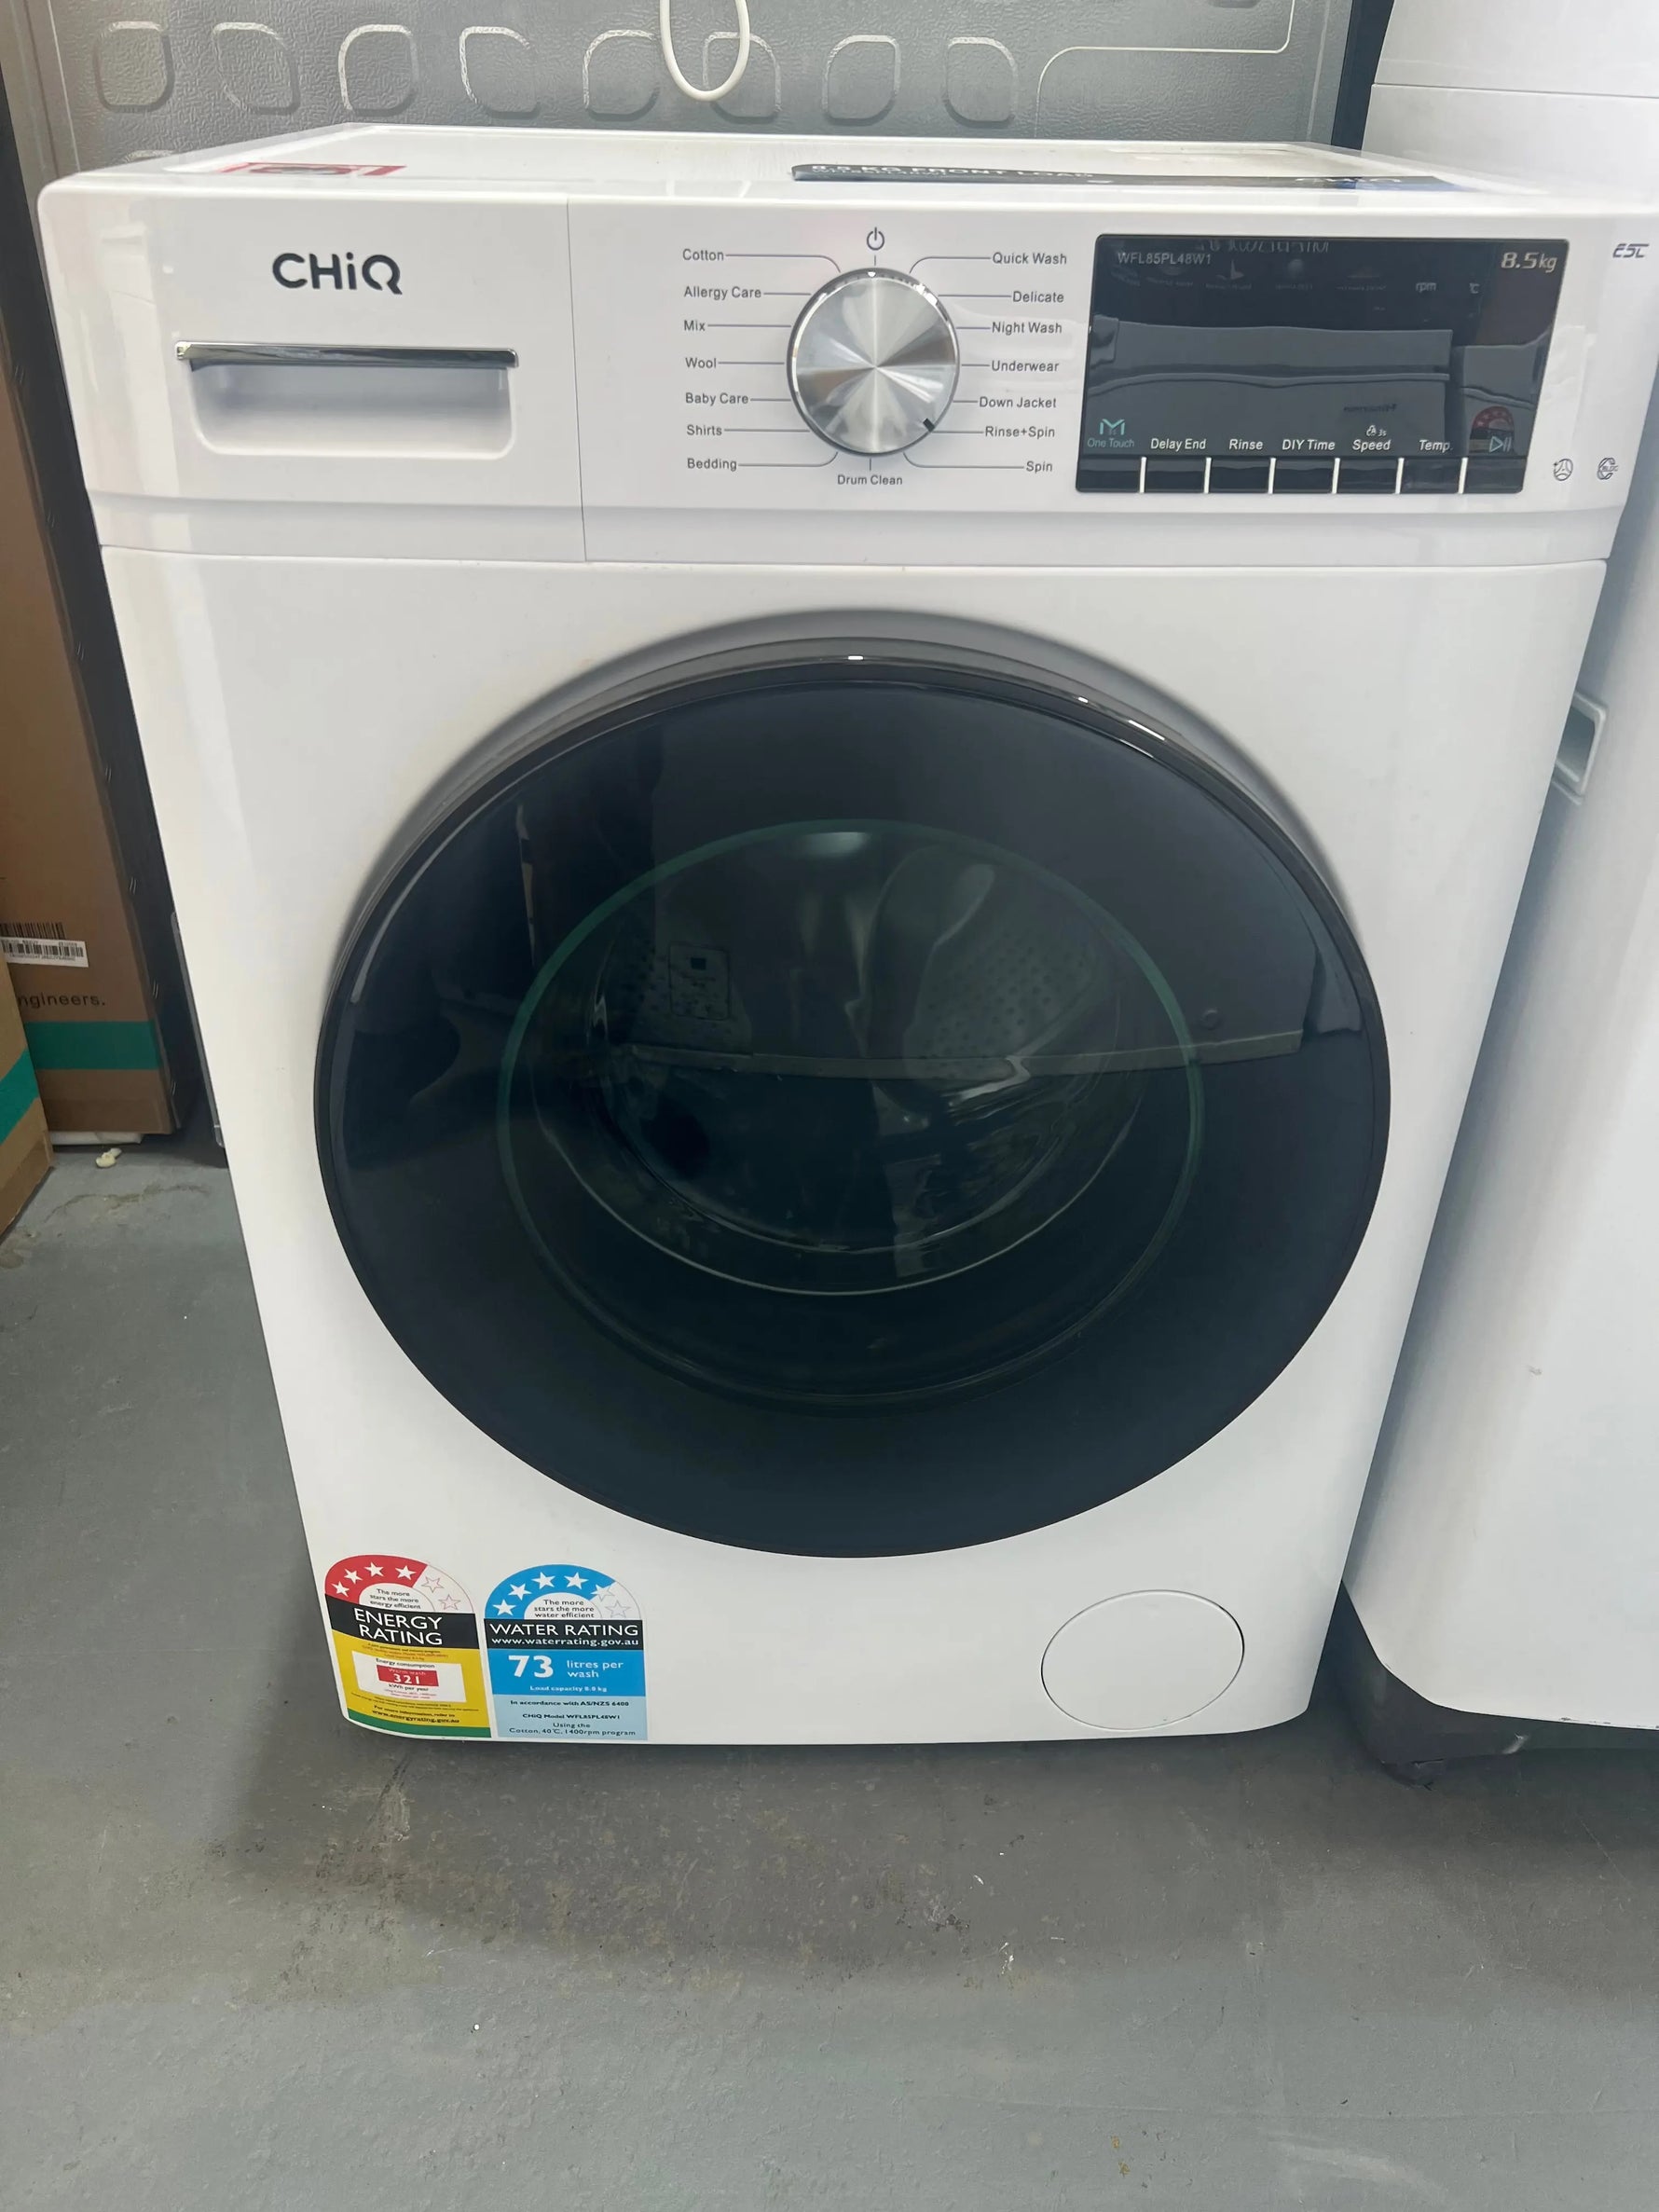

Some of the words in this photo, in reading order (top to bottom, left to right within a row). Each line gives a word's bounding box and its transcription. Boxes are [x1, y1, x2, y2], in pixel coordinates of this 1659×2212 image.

[912, 167, 1007, 175] FRONT
[682, 248, 724, 261] Cotton
[1611, 243, 1650, 258] ESC
[993, 252, 1029, 265] Quick
[1033, 253, 1067, 265] Wash
[1117, 252, 1212, 266] WFL85PL48W1
[272, 252, 403, 295] CHiQ
[683, 286, 728, 300] Allergy
[732, 286, 761, 298] Care
[1416, 282, 1437, 293] rpm
[1012, 290, 1064, 303] Delicate
[683, 320, 706, 332] Mix
[992, 322, 1024, 336] Night
[1028, 322, 1063, 334] Wash
[685, 358, 717, 369] Wool
[992, 360, 1059, 372] Underwear
[685, 392, 716, 406] Baby
[720, 392, 749, 405] Care
[980, 396, 1013, 408] Down
[1016, 397, 1057, 408] Jacket
[686, 424, 722, 436] Shirts
[985, 426, 1055, 439] Rinse+Spin
[1087, 437, 1107, 448] One
[1108, 437, 1135, 448] Touch
[1150, 437, 1184, 452] Delay
[1185, 438, 1207, 450] End
[1228, 438, 1264, 450] Rinse
[1282, 439, 1305, 451] DIY
[1307, 439, 1336, 451] Time
[1351, 439, 1392, 453] Speed
[687, 458, 737, 472] Bedding
[1026, 460, 1053, 474] Spin
[837, 474, 868, 486] Drum
[870, 474, 903, 486] Clean
[19, 991, 106, 1009] ngineers.
[370, 1601, 392, 1609] energy
[353, 1607, 443, 1630] ENERGY
[359, 1624, 443, 1645] RATING
[489, 1624, 559, 1636] WATER
[565, 1624, 638, 1636] RATING
[491, 1638, 639, 1647] www.waterrating.gov.au
[508, 1655, 554, 1678] 73
[567, 1660, 598, 1669] litres
[602, 1662, 624, 1670] per
[393, 1673, 420, 1685] 321
